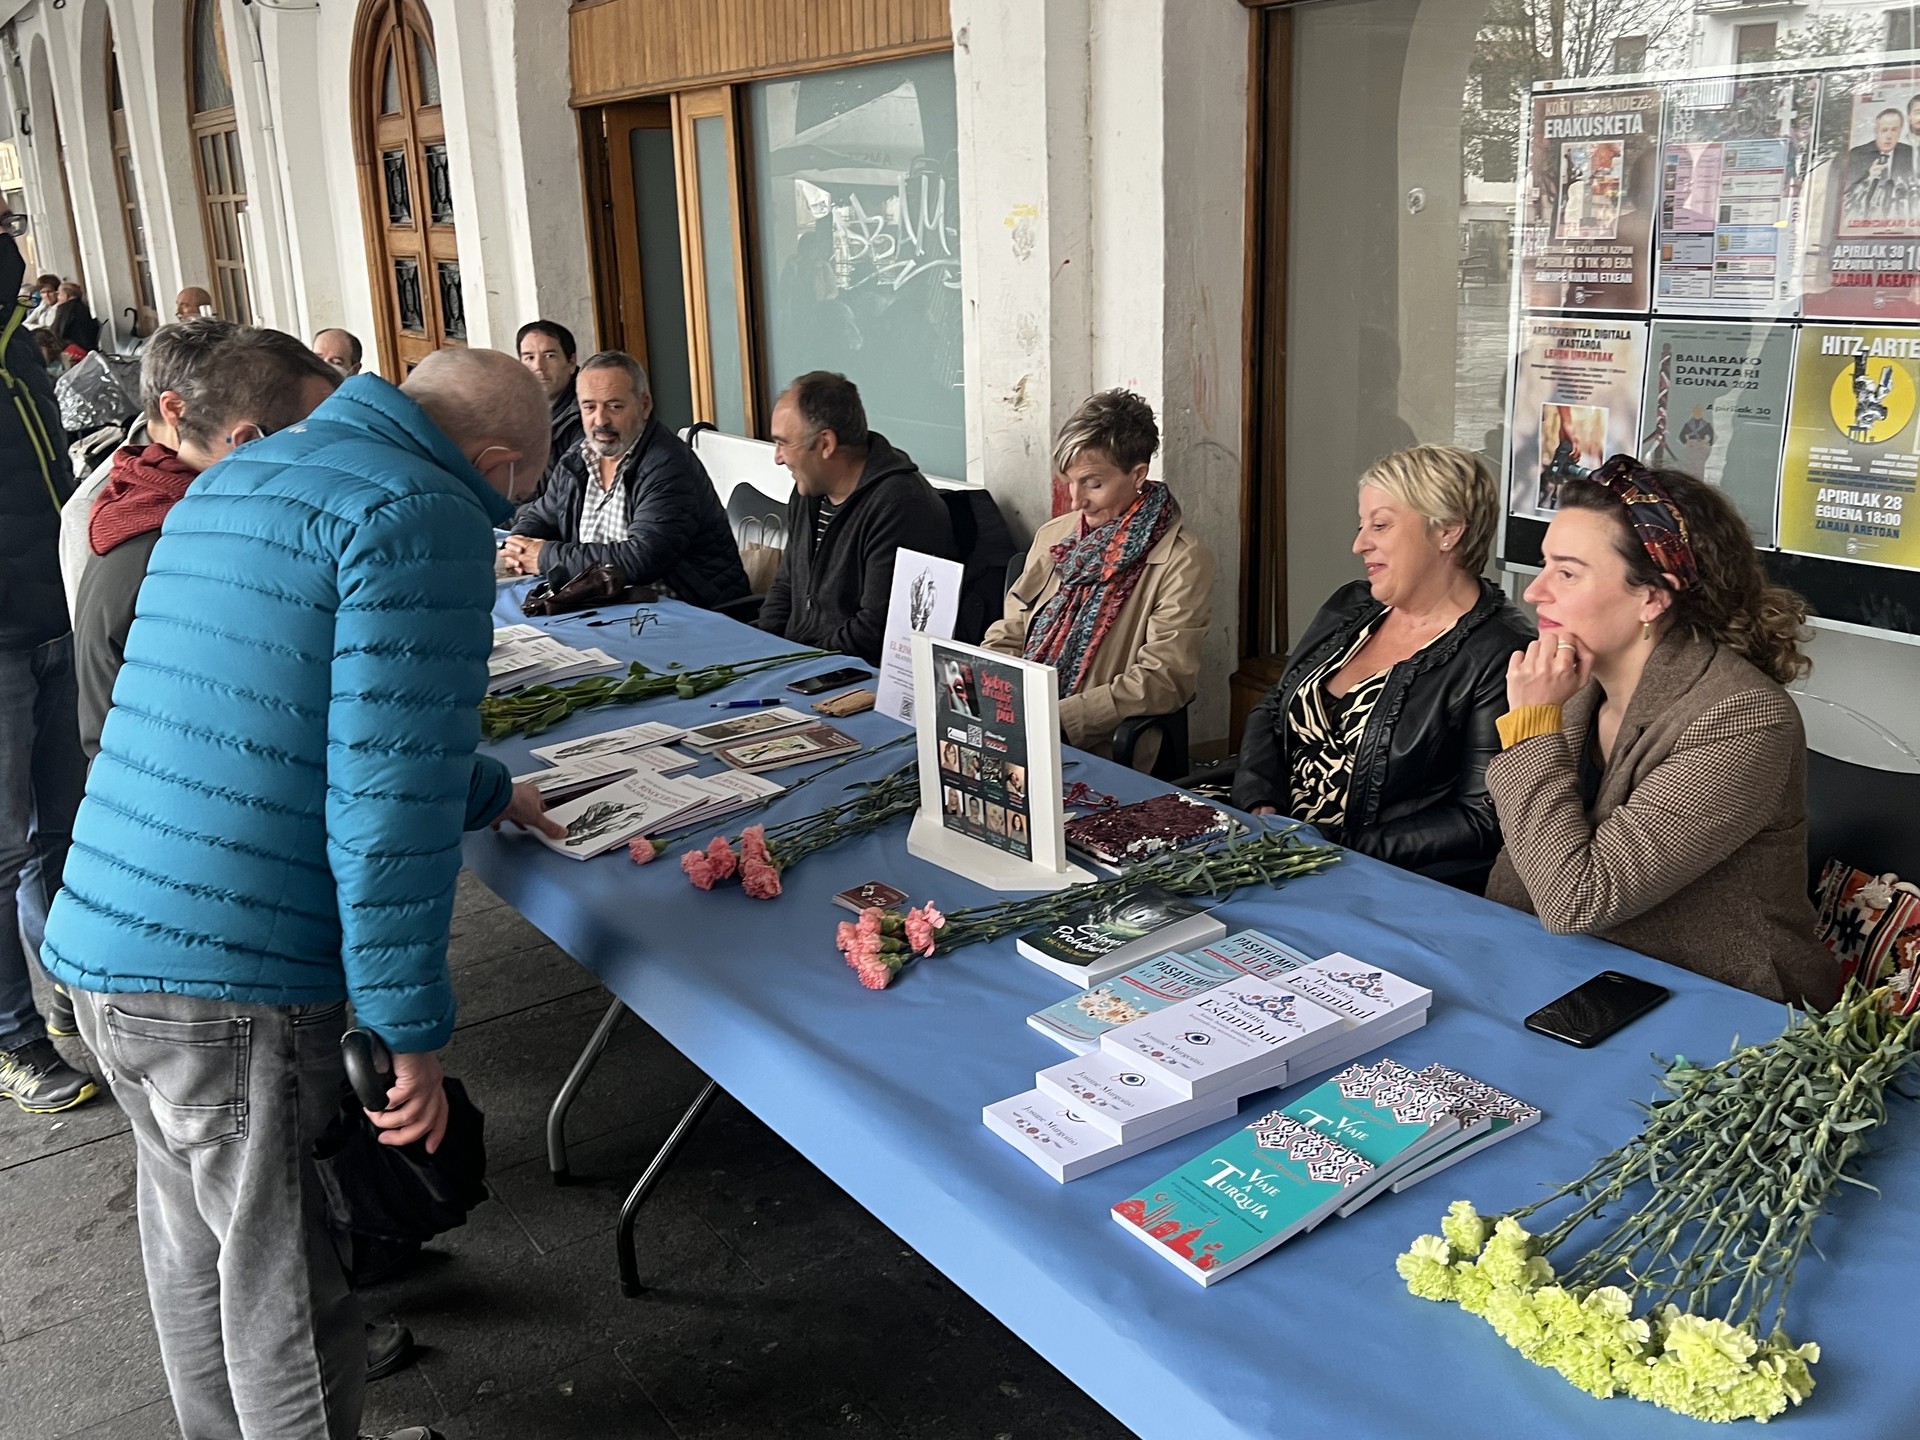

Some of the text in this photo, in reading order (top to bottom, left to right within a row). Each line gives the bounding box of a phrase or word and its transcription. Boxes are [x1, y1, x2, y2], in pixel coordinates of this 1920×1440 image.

[1544, 114, 1643, 138] ERAKUSKETA
[1833, 245, 1904, 258] APIRILAK 30
[1577, 257, 1583, 269] 6
[1600, 257, 1612, 269] 30
[1613, 257, 1633, 269] ERA
[1594, 329, 1632, 340] DIGITALA
[1557, 339, 1602, 350] IKASTAROA
[1675, 354, 1762, 366] BAILARAKO
[1675, 365, 1760, 379] DANTZARI
[1675, 377, 1759, 389] EGUNA 2022
[1706, 404, 1771, 415] Apirilak 30
[1816, 488, 1903, 511] APIRILAK 28
[1815, 505, 1901, 526] EGUENA 18:00
[1853, 524, 1900, 539] ARETOAN
[1288, 976, 1376, 1019] Estambul
[1314, 978, 1354, 1000] Destino
[1224, 1001, 1266, 1024] Destino
[1196, 999, 1287, 1045] Estambul
[1337, 1116, 1369, 1141] VIAJE
[1202, 1158, 1269, 1220] TURQUÍA
[1241, 1184, 1253, 1193] A
[1248, 1168, 1281, 1197] VIAJE
